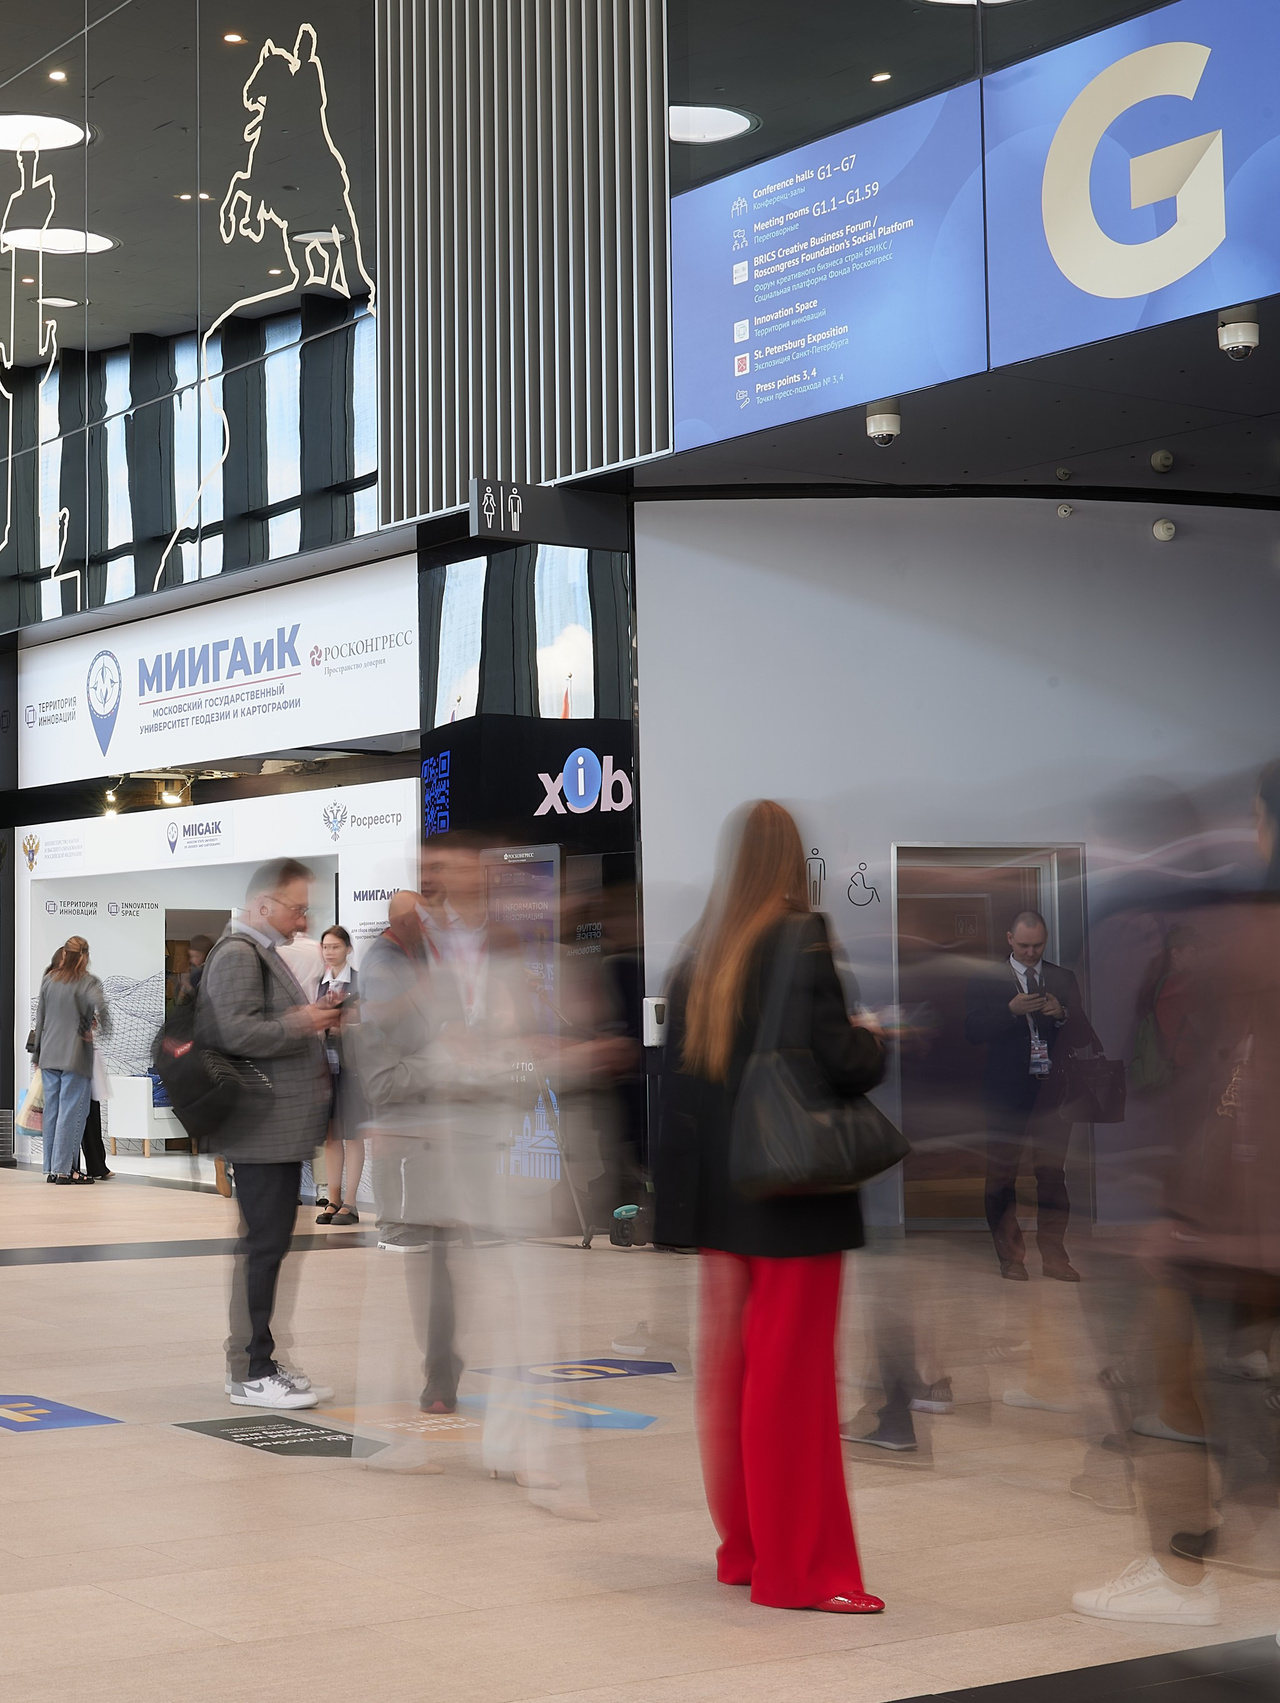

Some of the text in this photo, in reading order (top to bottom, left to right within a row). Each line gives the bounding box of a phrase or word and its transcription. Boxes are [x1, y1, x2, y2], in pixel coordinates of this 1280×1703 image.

[753, 177, 794, 199] Conference
[795, 169, 814, 183] halls
[1041, 41, 1226, 299] G
[752, 186, 805, 210] Конференц-залы
[753, 213, 784, 233] Meeting
[786, 206, 809, 221] rooms
[753, 223, 799, 244] Переговорные
[753, 215, 878, 267] BRICS Creative Business Forum /
[753, 258, 800, 280] Roscongress
[852, 232, 877, 247] Social
[878, 218, 914, 237] Platform
[753, 280, 776, 293] Форум
[776, 267, 815, 286] креативного
[817, 257, 844, 272] бизнеса
[844, 251, 863, 264] стран
[864, 243, 887, 256] БРИКС
[754, 252, 893, 303] Социальная платформа Фонда Росконгресс
[754, 299, 818, 326] Innovation Space
[754, 308, 826, 338] Территория инноваций
[753, 324, 848, 360] St. Petersburg Exposition
[754, 337, 849, 372] Экспозиция Санкт-Петербурга
[755, 367, 817, 394] Press points 3, 4
[756, 393, 774, 405] Точки
[775, 381, 821, 402] пресс-подхода
[822, 376, 831, 386] №
[324, 630, 413, 661] РОСКОНГРЕСС
[138, 623, 301, 697] МИИГАиК
[324, 657, 386, 677] Пространство доверия
[38, 696, 77, 712] ТЕРРИТОРИЯ
[152, 683, 285, 718] МОСКОВСКИЙ ГОСУДАРСТВЕННЫЙ
[38, 710, 76, 727] ИННОВАЦИЙ
[139, 697, 301, 735] УНИВЕРСИТЕТ ГЕОДЕЗИИ И КАРТОГРАФИИ
[183, 821, 221, 837] MIIGAiK
[350, 812, 402, 829] Росреестр
[59, 908, 97, 916] ИННОВАЦИЙ
[121, 902, 159, 910] INNOVATION
[503, 901, 549, 912] INFORMATION
[503, 912, 544, 922] ИНФОРМАЦИЯ
